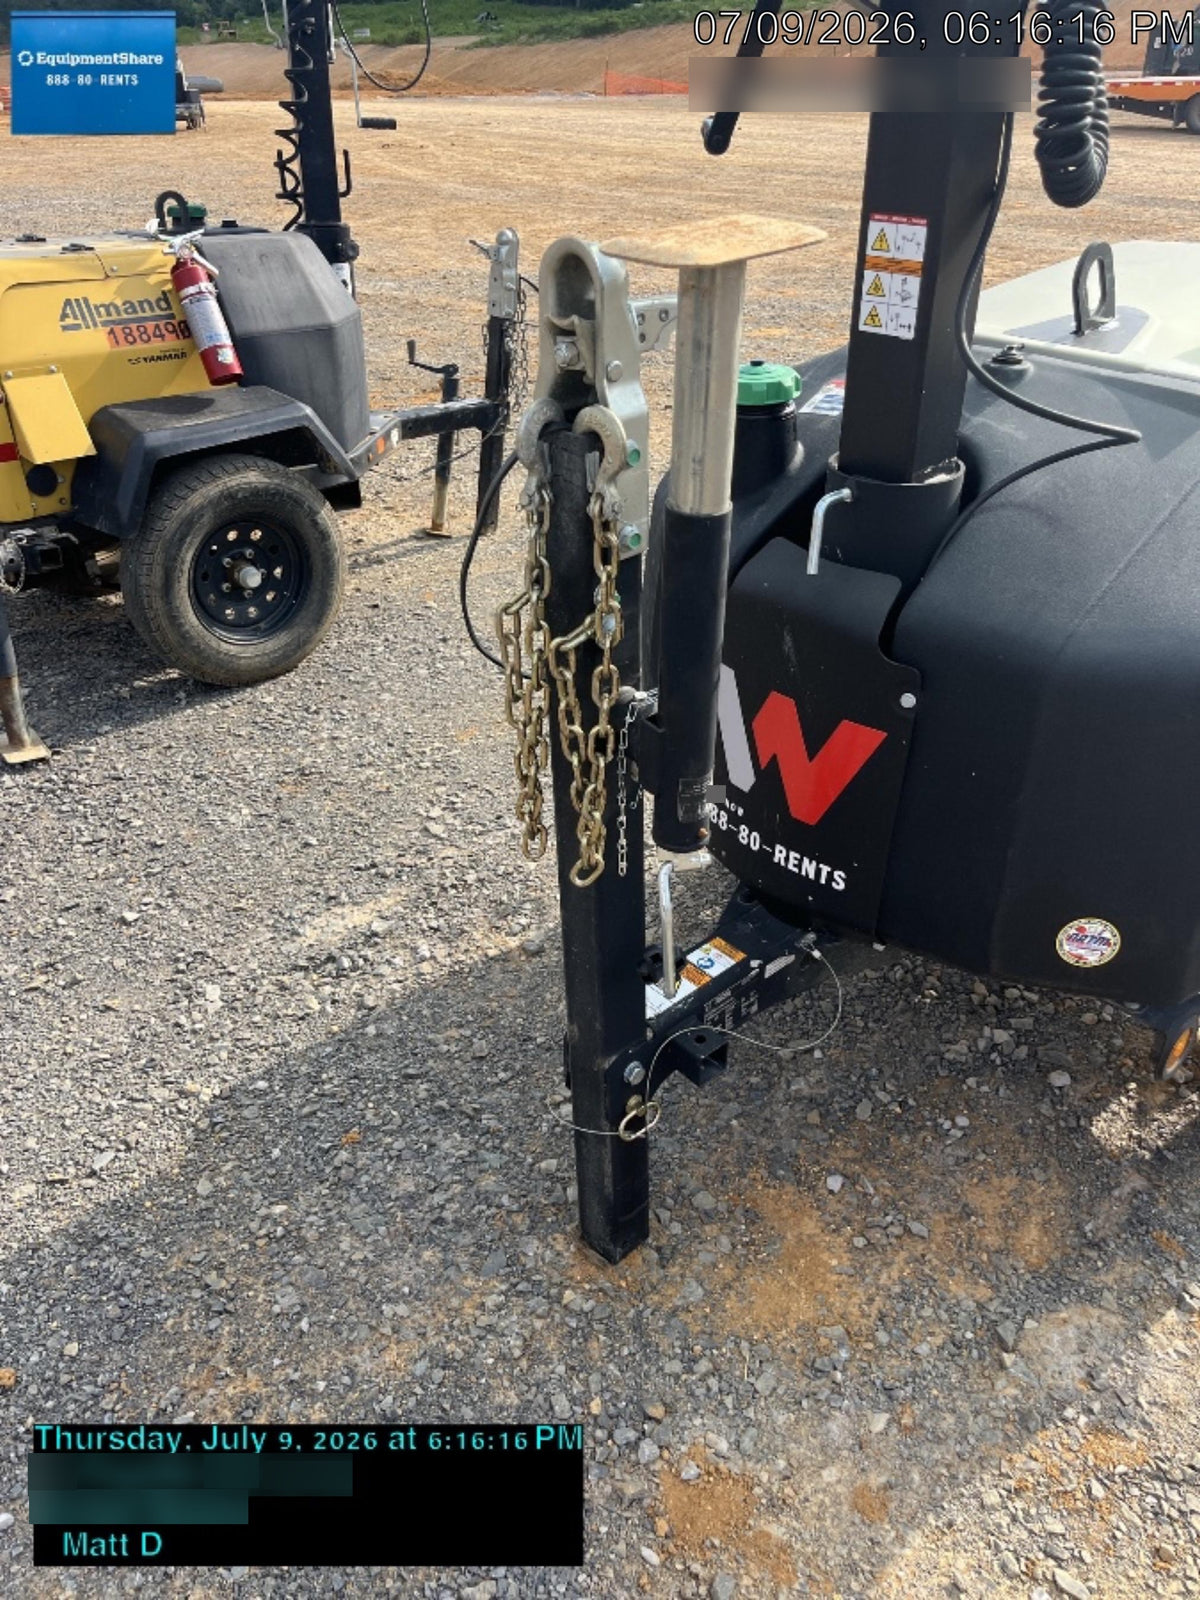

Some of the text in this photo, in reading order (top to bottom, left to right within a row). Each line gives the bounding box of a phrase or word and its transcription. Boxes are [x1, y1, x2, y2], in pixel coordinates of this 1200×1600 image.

[36, 52, 164, 66] EquipmentShare
[59, 290, 175, 331] Allmand
[705, 803, 847, 891] 88-80-RENTS
